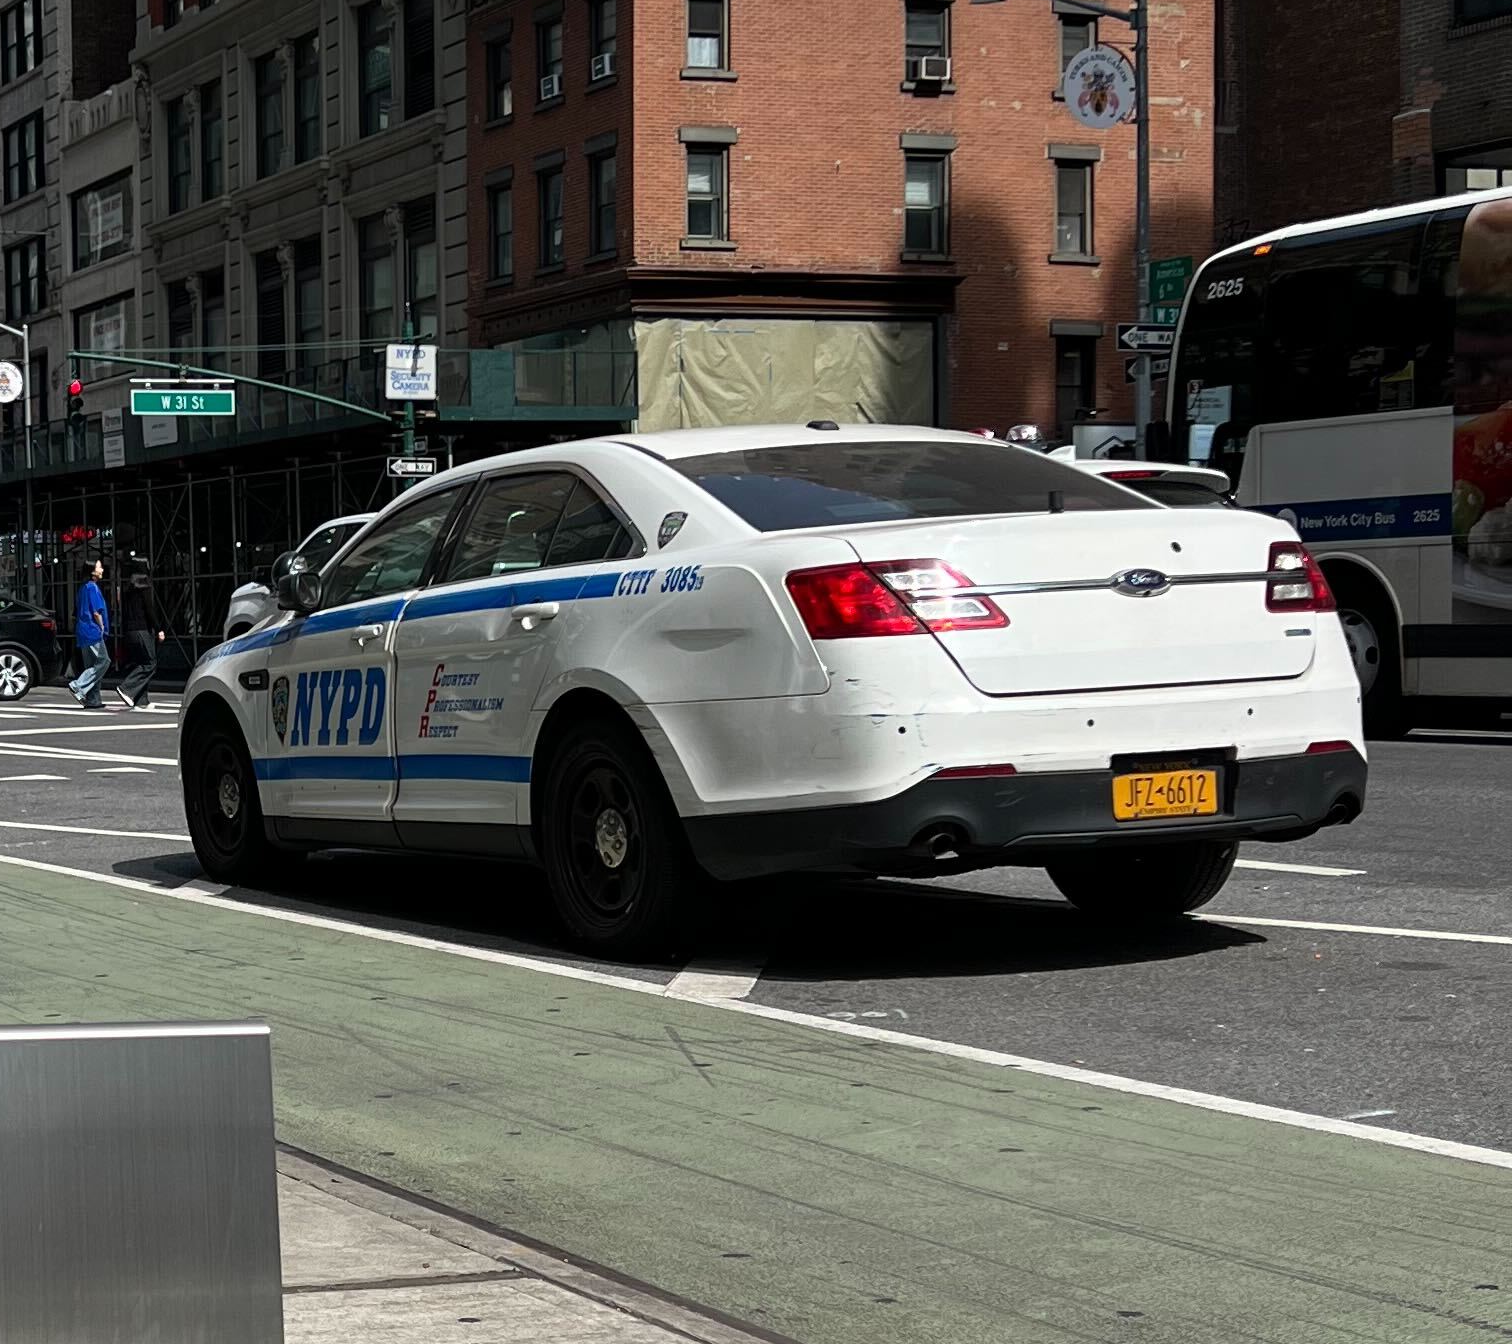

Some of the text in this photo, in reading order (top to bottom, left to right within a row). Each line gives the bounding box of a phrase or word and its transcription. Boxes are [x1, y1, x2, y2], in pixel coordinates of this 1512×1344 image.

[1207, 277, 1245, 300] 2625
[1156, 307, 1166, 323] W
[1128, 333, 1148, 343] ONE
[396, 349, 426, 360] NYD
[392, 380, 430, 391] CAMERA
[160, 395, 205, 411] W 31 St
[1300, 512, 1396, 529] New York City Bus
[1413, 509, 1441, 523] 2625
[660, 564, 702, 593] 3085
[290, 666, 387, 748] NYPD
[1125, 774, 1207, 808] JFZ 6612
